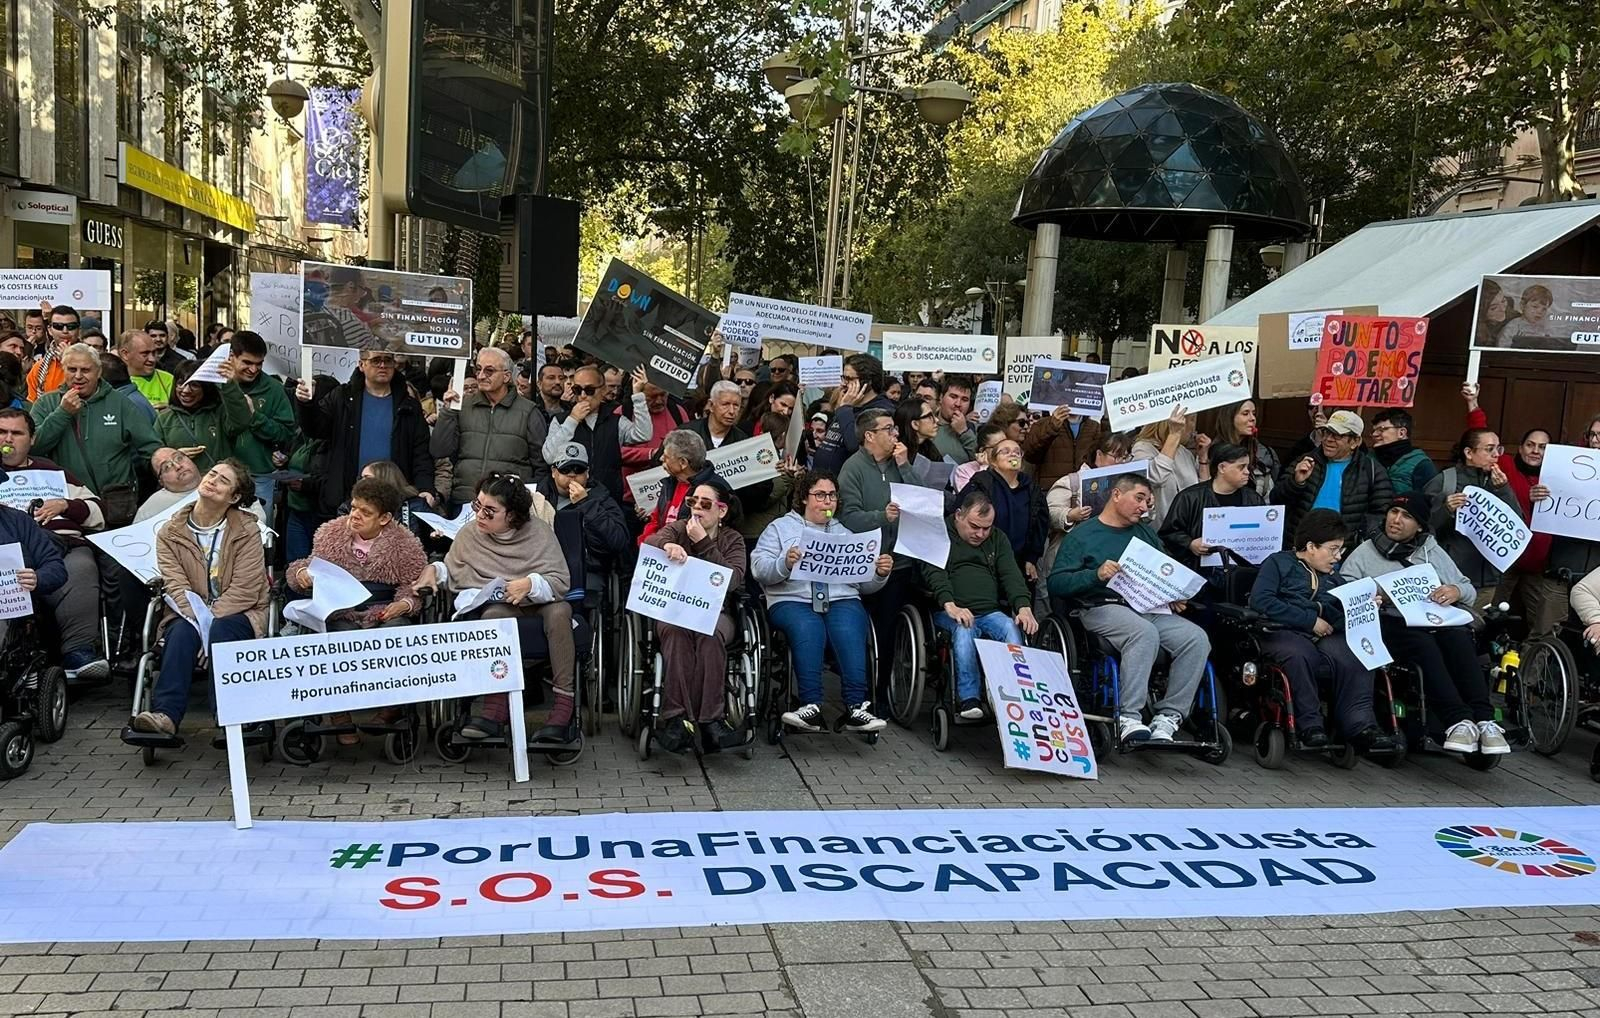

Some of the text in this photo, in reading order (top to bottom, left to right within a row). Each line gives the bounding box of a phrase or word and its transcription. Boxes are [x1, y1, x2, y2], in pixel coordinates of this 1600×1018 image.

[27, 201, 69, 212] Soloptical
[87, 219, 123, 249] GUESS
[607, 278, 654, 311] DOWN
[380, 312, 395, 320] SIN
[731, 298, 744, 306] POR
[745, 299, 755, 307] UN
[756, 302, 779, 311] NUEVO
[780, 305, 808, 315] MODELO
[819, 311, 865, 325] FINANCIACIÓN
[1565, 315, 1600, 323] FINANCI
[722, 319, 752, 328] JUNTOS
[756, 311, 791, 323] ADECUADA
[797, 317, 834, 329] SOSTENIBLE
[429, 325, 460, 334] NO HAY
[642, 329, 654, 341] SIN
[722, 326, 759, 338] PODEMOS
[1332, 320, 1414, 350] JUNTOS
[410, 334, 459, 346] FUTURO
[1577, 334, 1598, 342] FUT
[888, 344, 977, 354] #PorUnaFinanciaciónJusta
[1208, 341, 1220, 355] A
[1225, 341, 1254, 354] LOS
[672, 355, 694, 370] NO HAY
[916, 353, 973, 362] DISCAPACIDAD
[1327, 349, 1421, 379] PODEMOS
[653, 358, 689, 382] FUTURO
[1007, 364, 1034, 374] PODE
[1113, 374, 1221, 406] #PorUnaFinanciaciónJusta
[1320, 376, 1415, 405] EVITARLO
[1120, 385, 1218, 415] S.O.S. DISCAPACIDAD
[1468, 491, 1516, 531] JUNTOS
[1538, 496, 1600, 520] DISC
[1460, 500, 1521, 551] PODEMOS
[806, 540, 864, 554] JUNTOS
[641, 556, 669, 572] #Por
[803, 551, 875, 565] PODEMOS
[645, 569, 668, 584] Una
[799, 561, 868, 576] EVITARLO
[1392, 576, 1429, 588] JUNTOS
[638, 592, 668, 608] Justa
[641, 580, 710, 610] Financiación
[1346, 602, 1375, 619] PODEMOS
[1347, 613, 1376, 630] EVITARLO
[236, 629, 498, 663] POR LA ESTABILIDAD DE LAS ENTIDADES
[221, 646, 512, 685] SOCIALES Y DE LOS SERVICIOS QUE PRESTAN
[291, 673, 457, 701] #porunafinanciacionjusta
[330, 828, 1377, 869] #PorUnaFinanciaciónJusta
[379, 858, 1377, 910] S.O.S. DISCAPACIDAD
